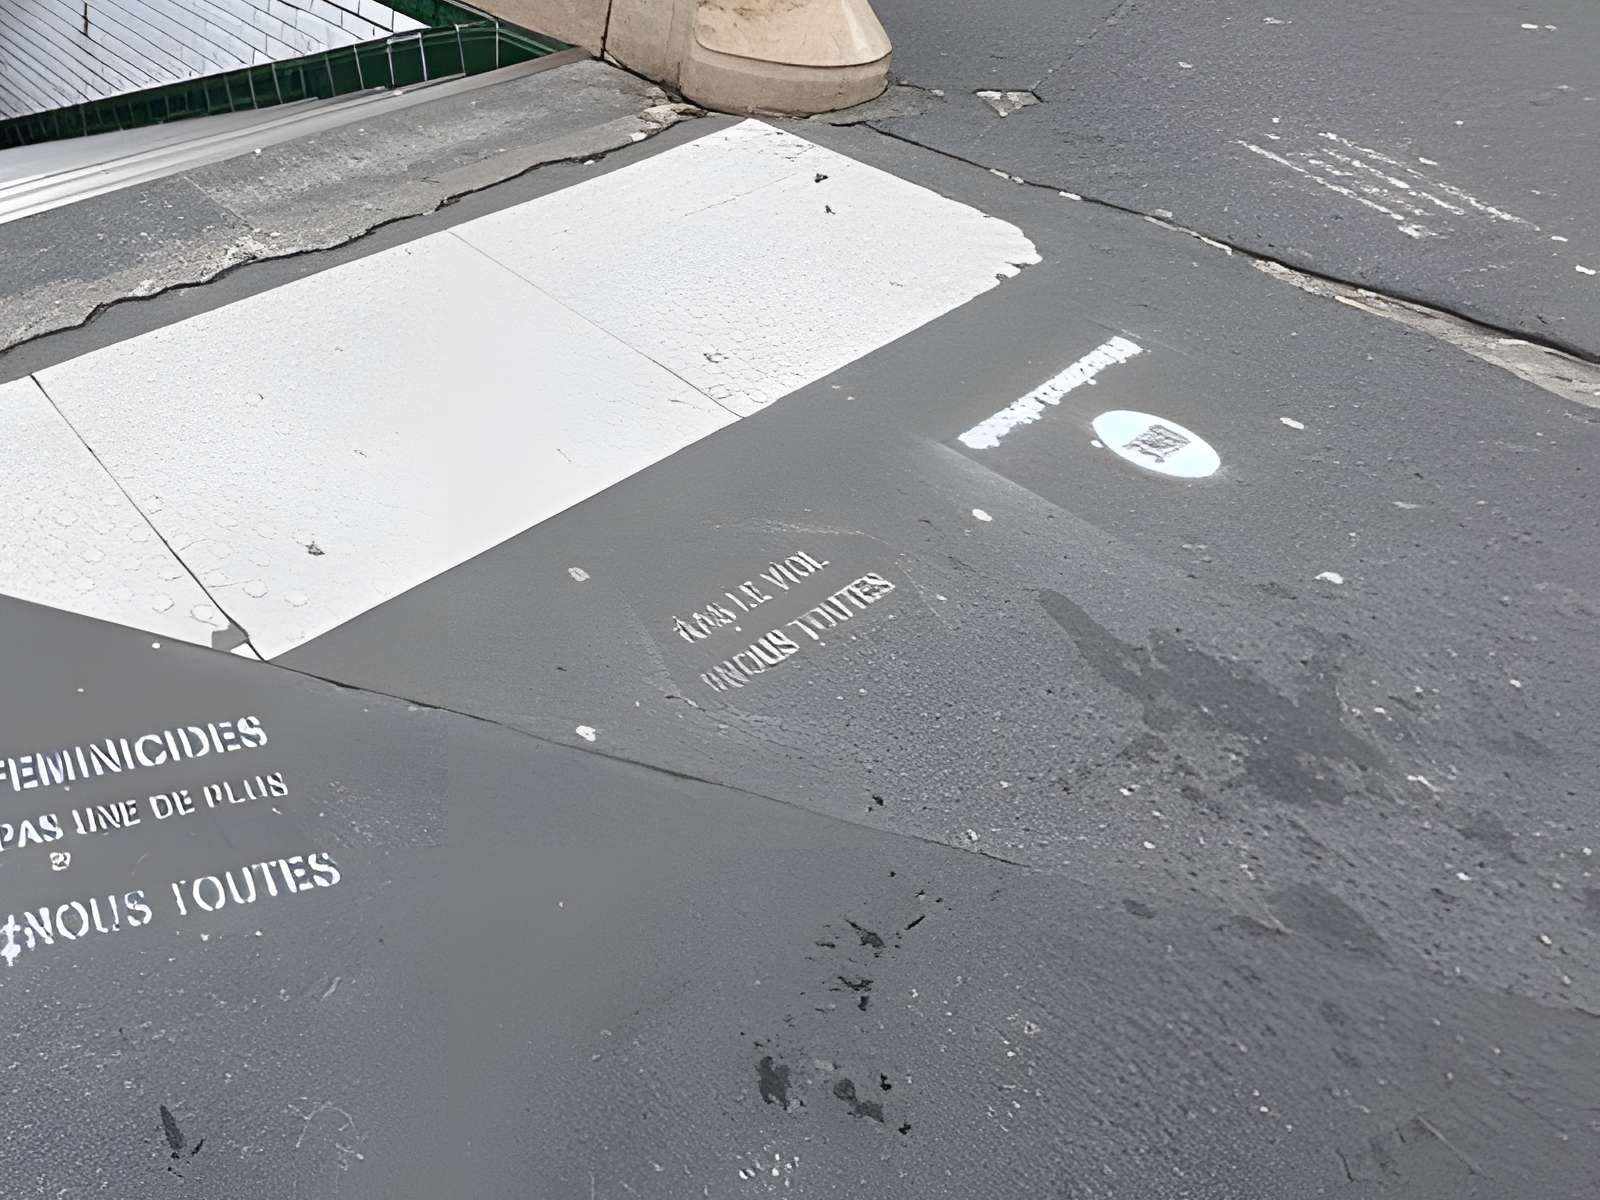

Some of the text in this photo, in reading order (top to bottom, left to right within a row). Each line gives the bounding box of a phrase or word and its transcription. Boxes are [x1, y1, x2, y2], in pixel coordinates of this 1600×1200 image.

[760, 551, 831, 590] VIOL
[72, 799, 142, 836] UNE
[149, 790, 196, 820] DE
[203, 772, 289, 808] PLUS
[171, 852, 342, 916] TOUTES
